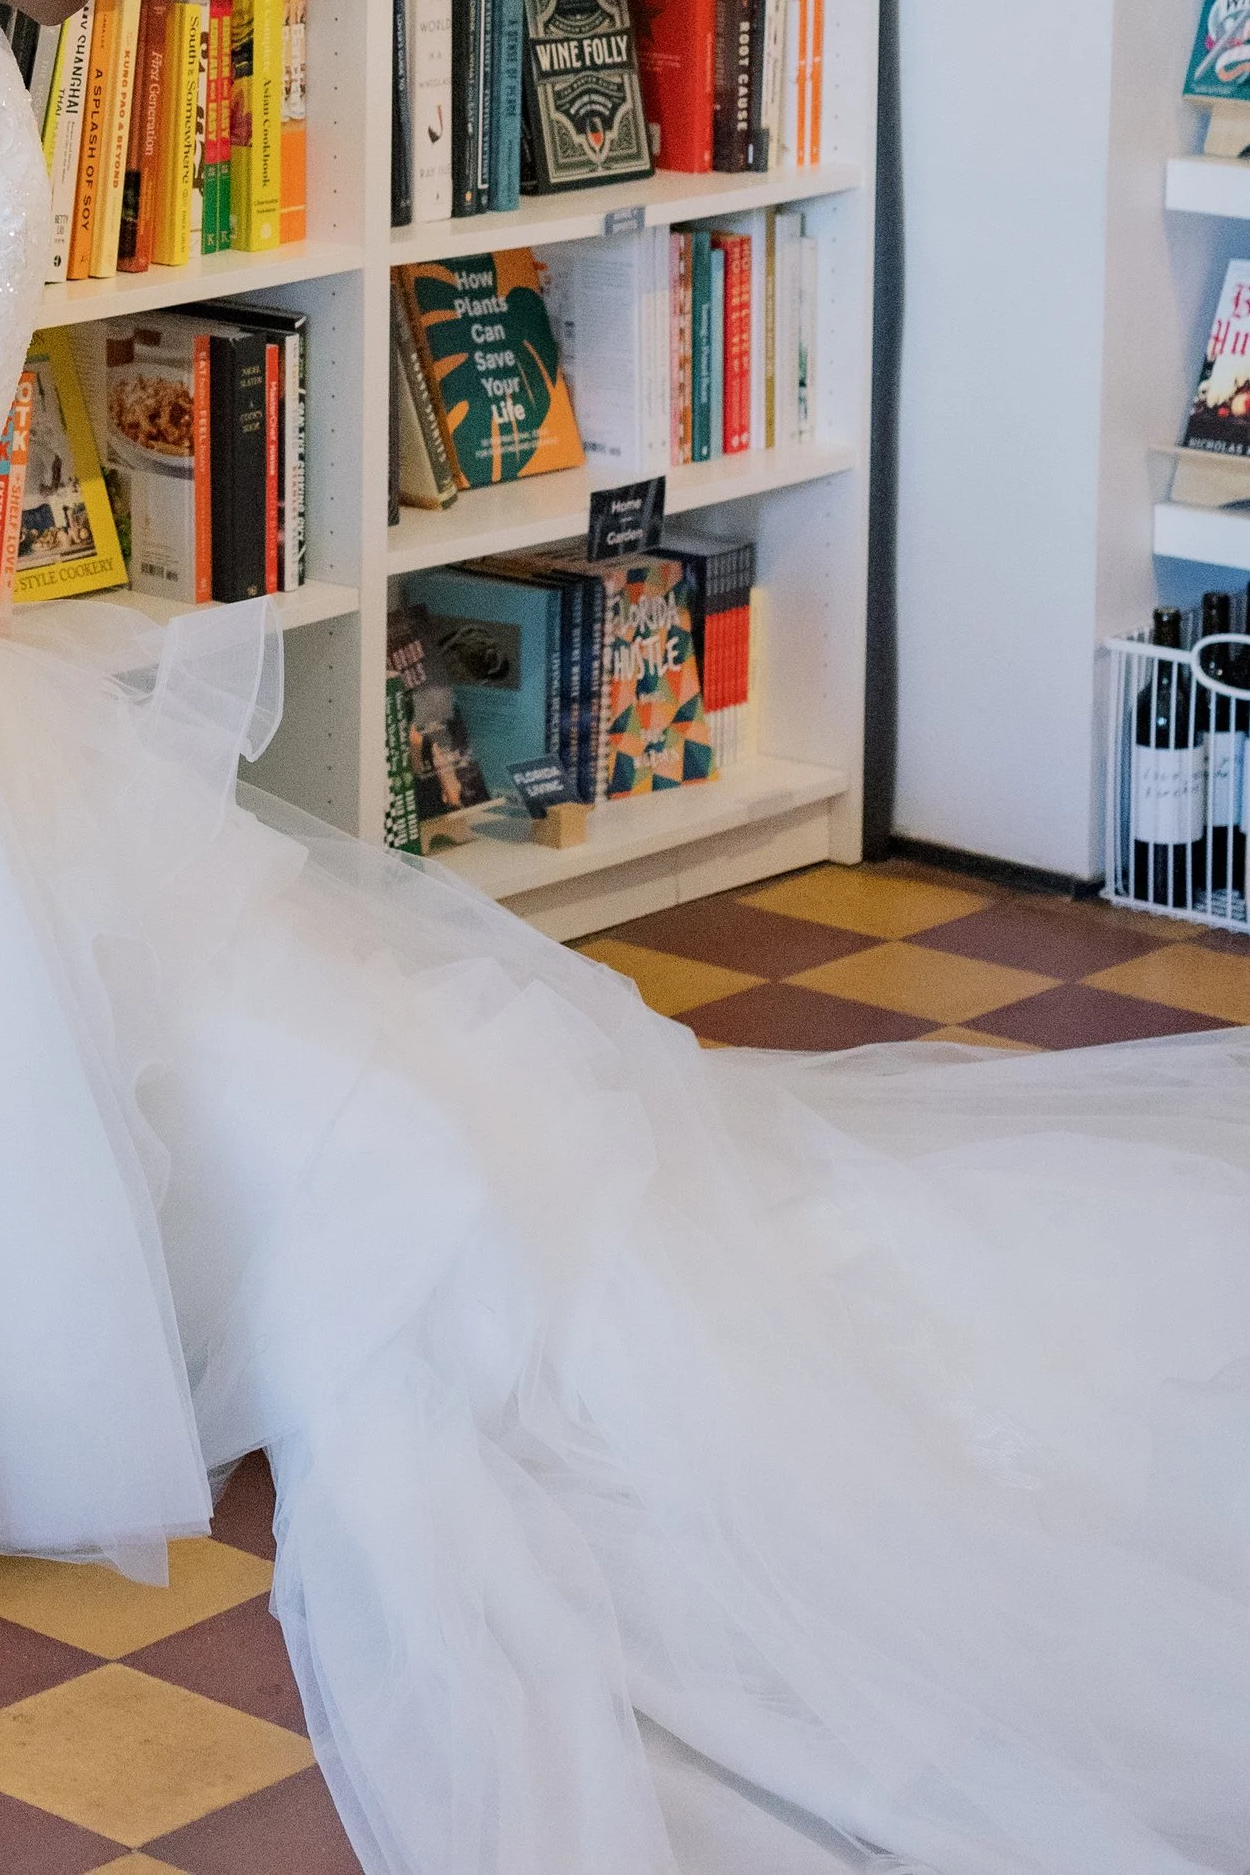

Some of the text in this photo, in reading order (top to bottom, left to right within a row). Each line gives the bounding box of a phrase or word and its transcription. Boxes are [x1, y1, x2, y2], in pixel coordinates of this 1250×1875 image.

[534, 34, 630, 71] WINE FOLLY
[144, 51, 164, 157] First Generation
[79, 68, 104, 232] A SPLASH OF SOY
[455, 270, 494, 292] How
[453, 295, 508, 319] Plants
[471, 322, 505, 344] Can
[474, 349, 515, 371] Save
[480, 376, 520, 398] Your
[490, 402, 526, 425] Life
[611, 497, 642, 515] Home
[606, 529, 645, 547] Garden
